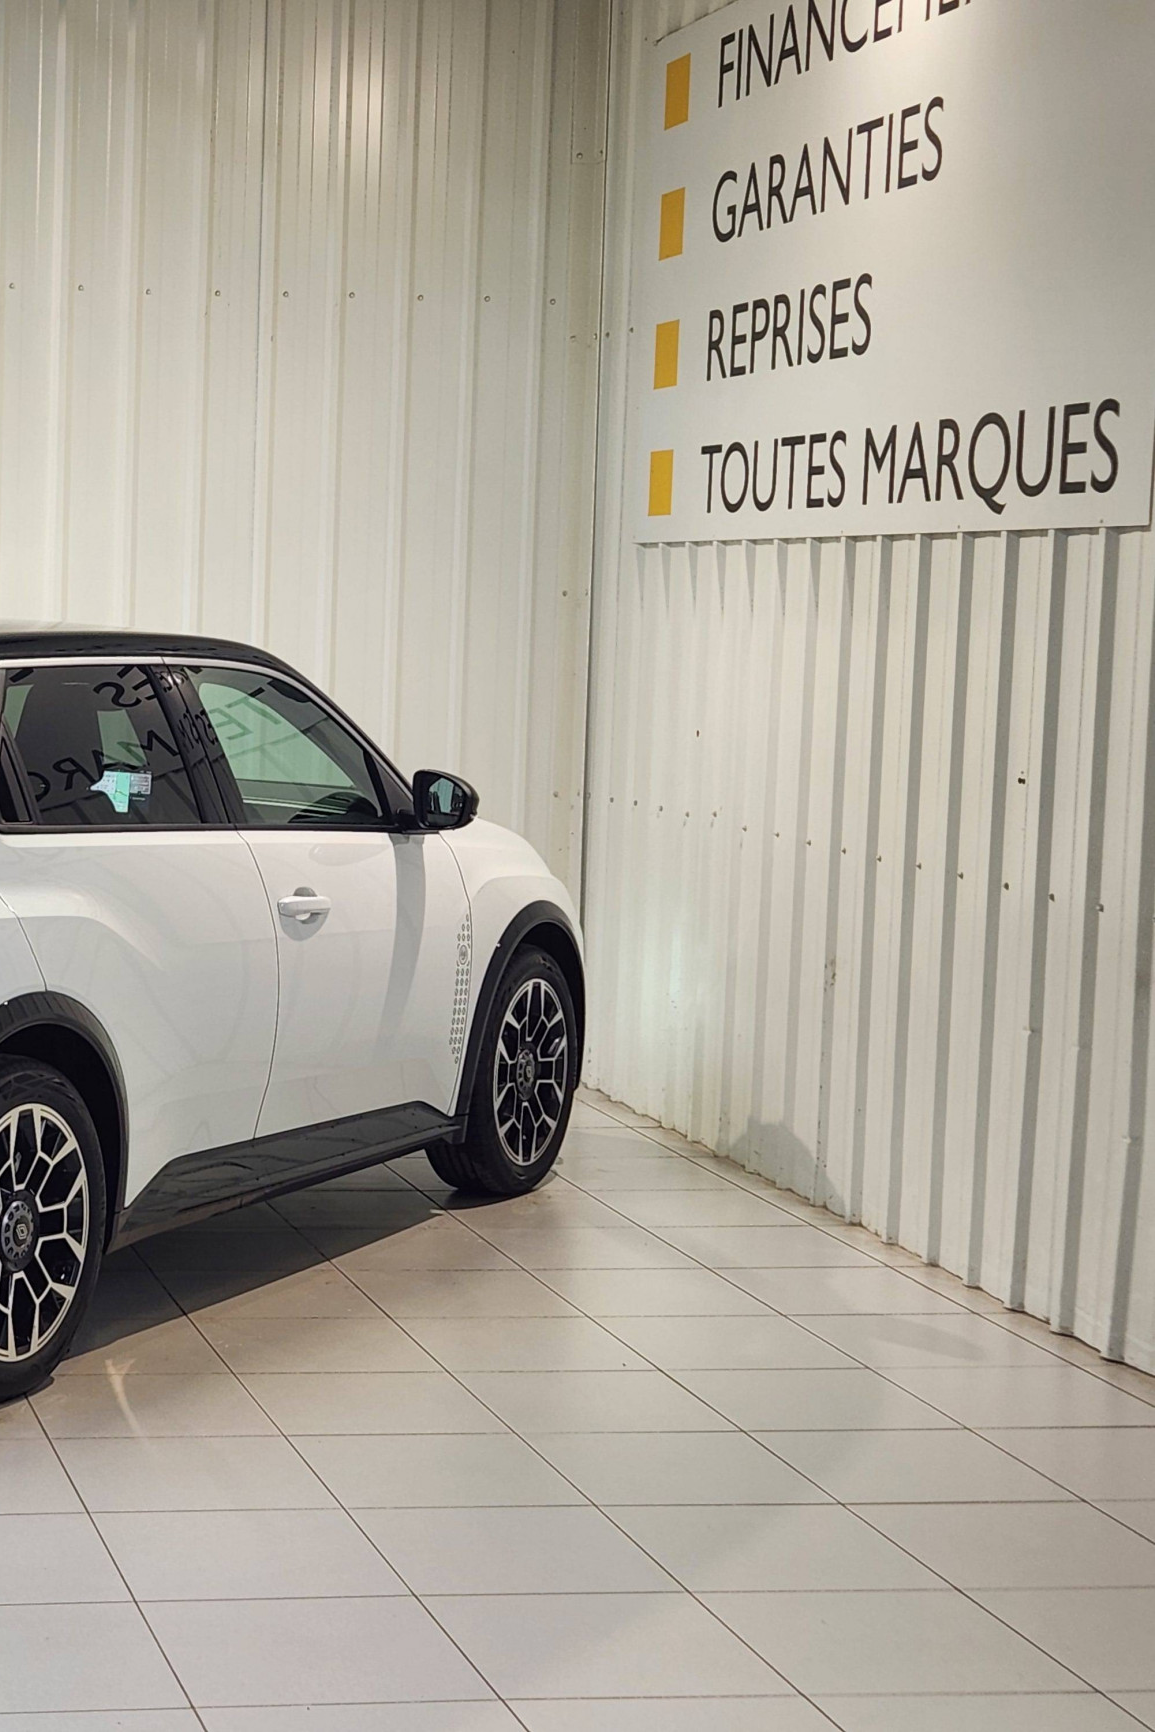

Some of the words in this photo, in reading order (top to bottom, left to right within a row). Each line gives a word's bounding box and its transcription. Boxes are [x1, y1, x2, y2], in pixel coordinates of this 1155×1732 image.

[712, 97, 944, 242] GARANTIES
[706, 273, 873, 381] REPRISES
[701, 431, 847, 513] TOUTES
[862, 398, 1120, 515] MARQUES
